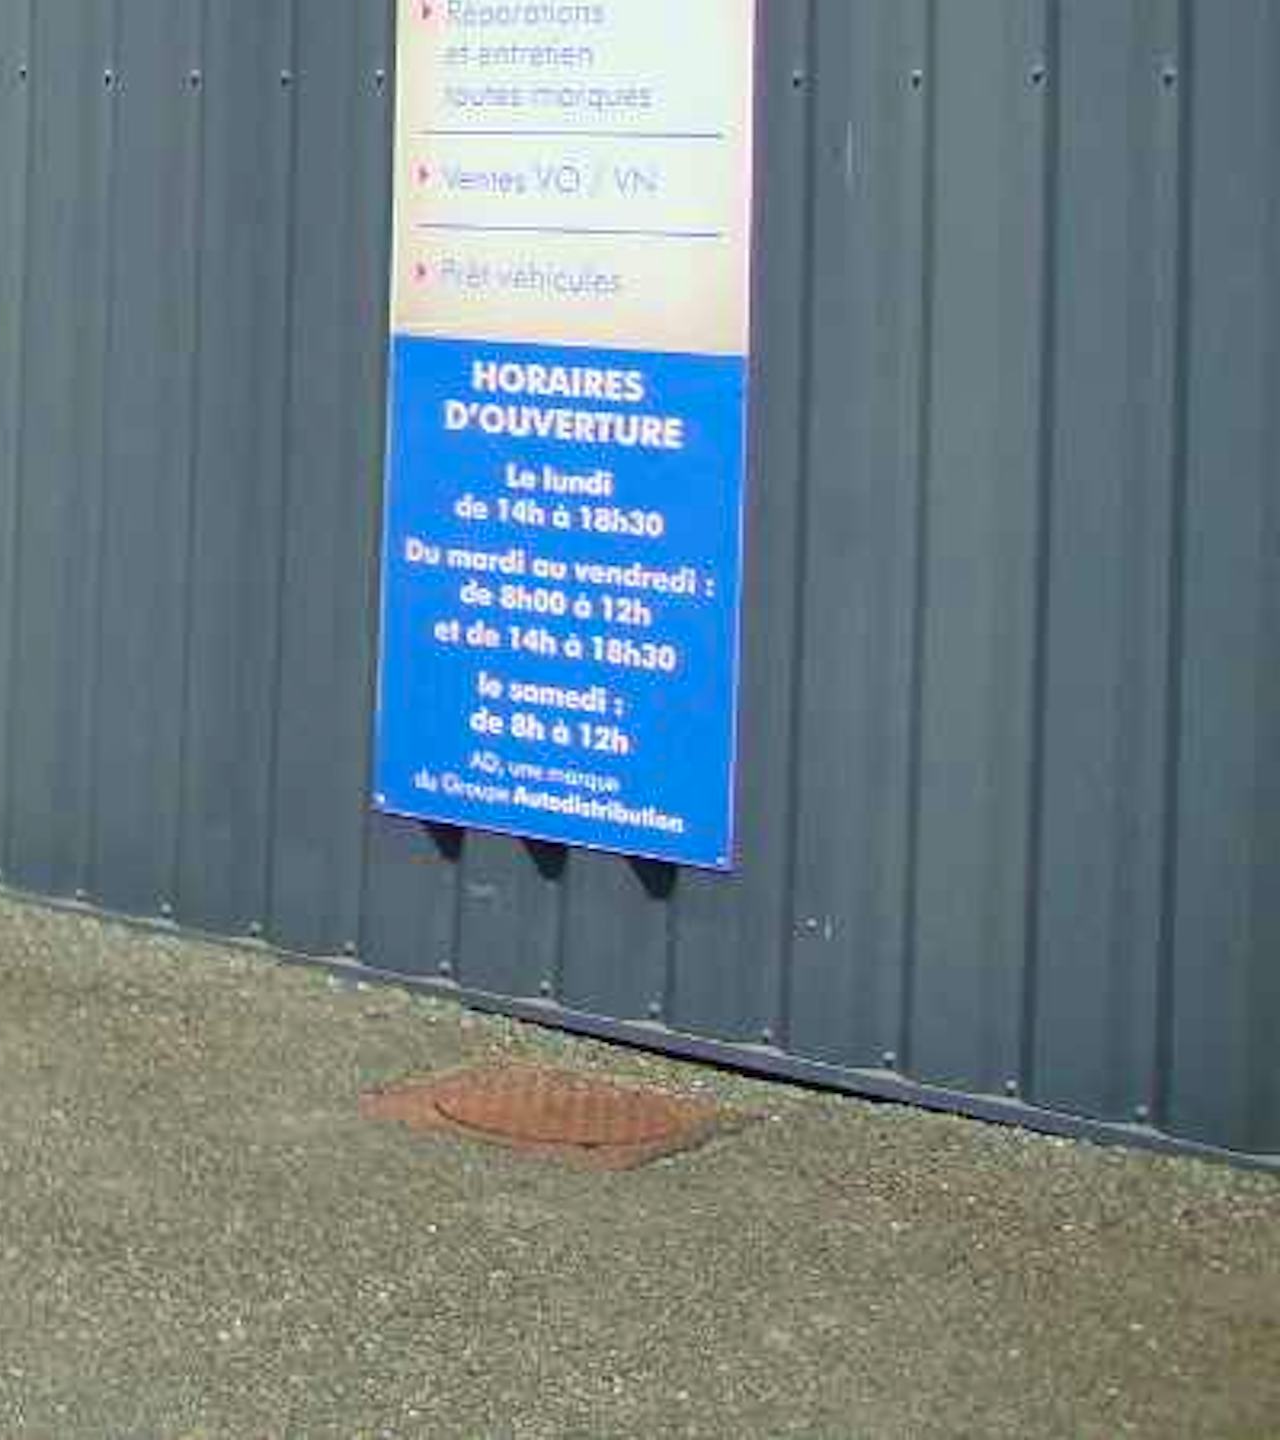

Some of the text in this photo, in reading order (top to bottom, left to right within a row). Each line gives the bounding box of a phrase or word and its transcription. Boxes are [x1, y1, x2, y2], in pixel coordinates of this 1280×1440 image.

[479, 41, 594, 66] entretien
[531, 87, 654, 113] marques
[443, 164, 527, 194] Ventes
[537, 164, 581, 194] VO
[614, 165, 659, 194] VN
[471, 360, 645, 402] HORAIRES
[443, 398, 685, 449] D'OUVERTURE
[505, 462, 614, 496] Le lundi
[454, 492, 664, 539] de 14h à 18h30
[405, 537, 440, 565] Du
[447, 546, 526, 574] mardi
[532, 558, 568, 579] au
[574, 561, 697, 594] vendredi
[459, 579, 653, 627] de 8h00 à 12h
[433, 620, 678, 671] et de 14h à 18h30
[508, 682, 607, 715] samedi
[468, 706, 631, 755] de 8h à 12h
[508, 762, 540, 782] une
[543, 767, 620, 792] marque
[413, 766, 686, 835] du Groupe Autodistribution
